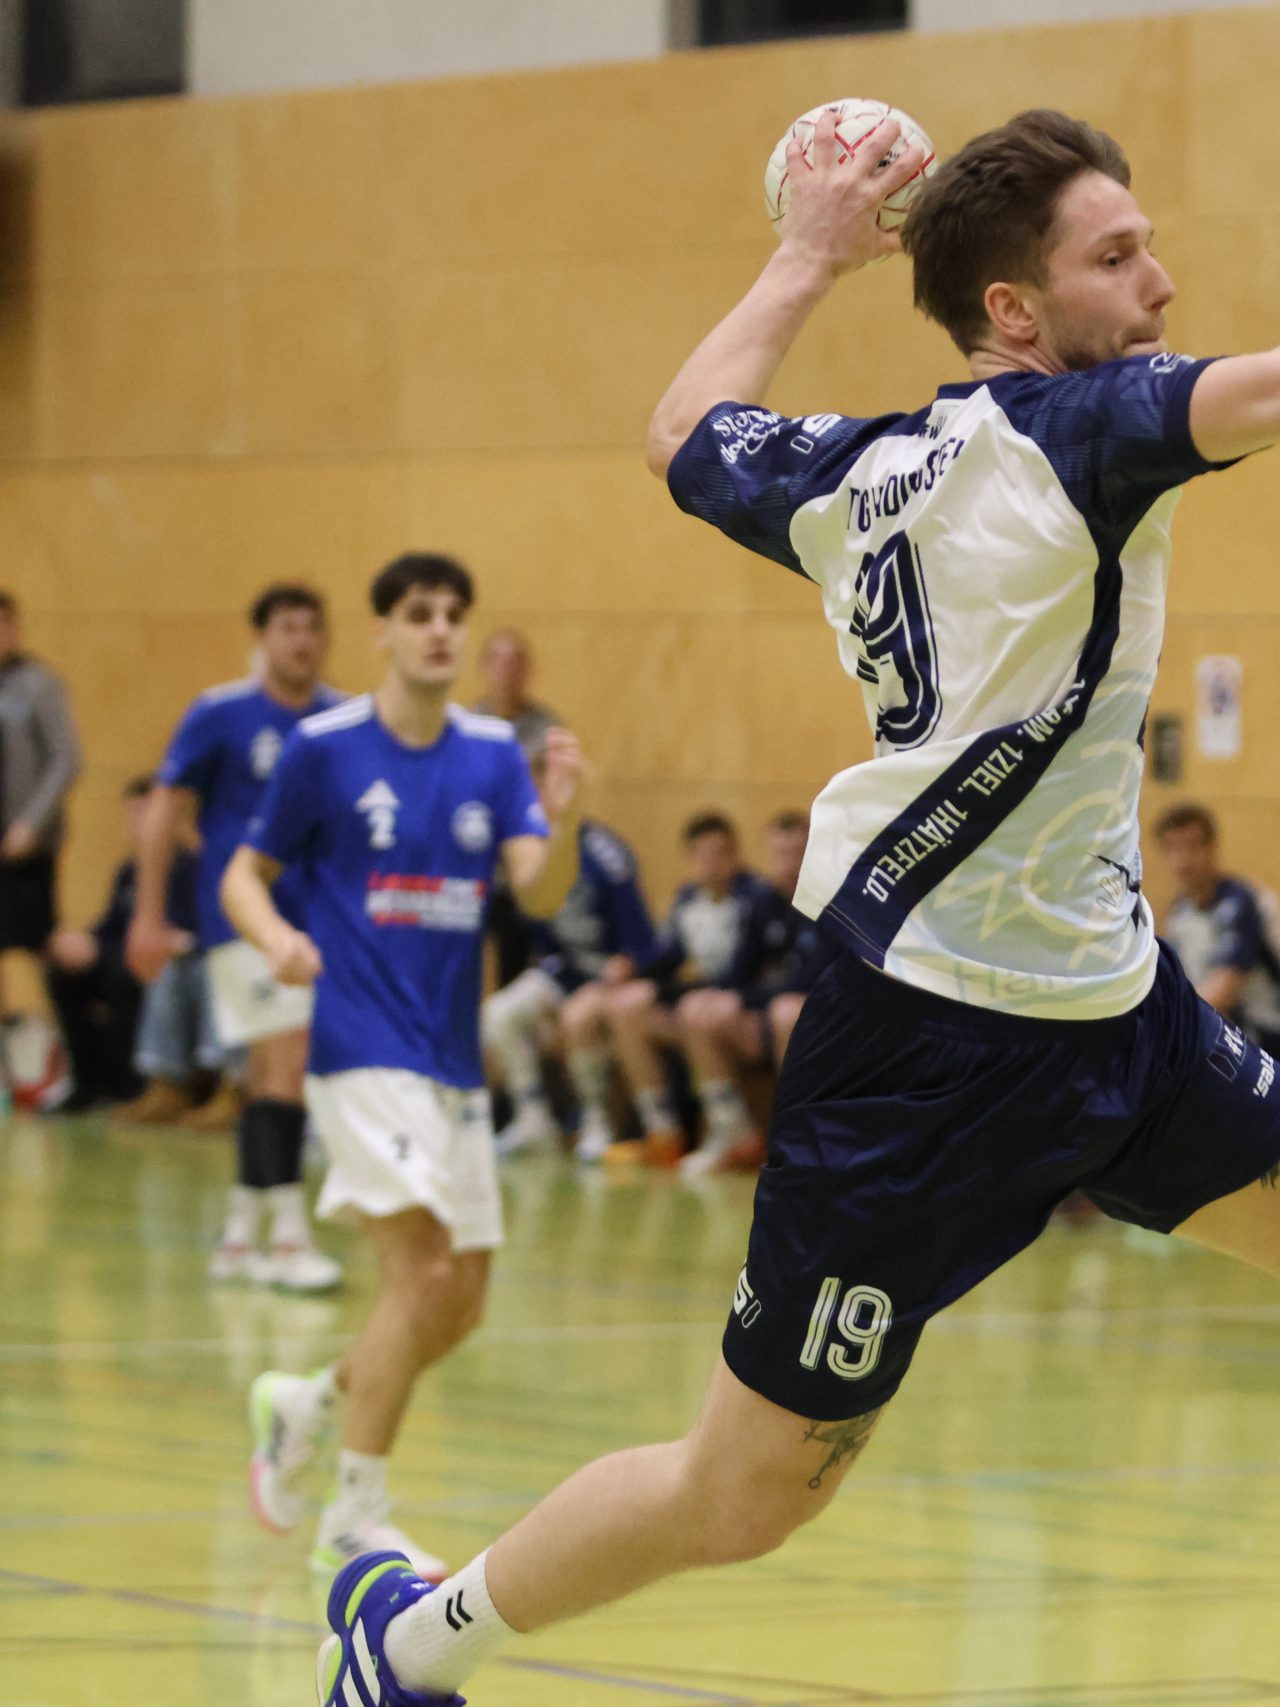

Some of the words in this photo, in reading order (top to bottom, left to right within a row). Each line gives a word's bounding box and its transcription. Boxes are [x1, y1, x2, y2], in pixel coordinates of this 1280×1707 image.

[956, 740, 1025, 797] 1ZIEL.
[862, 799, 970, 903] 1HÄTZFELD.
[798, 1276, 894, 1381] 19
